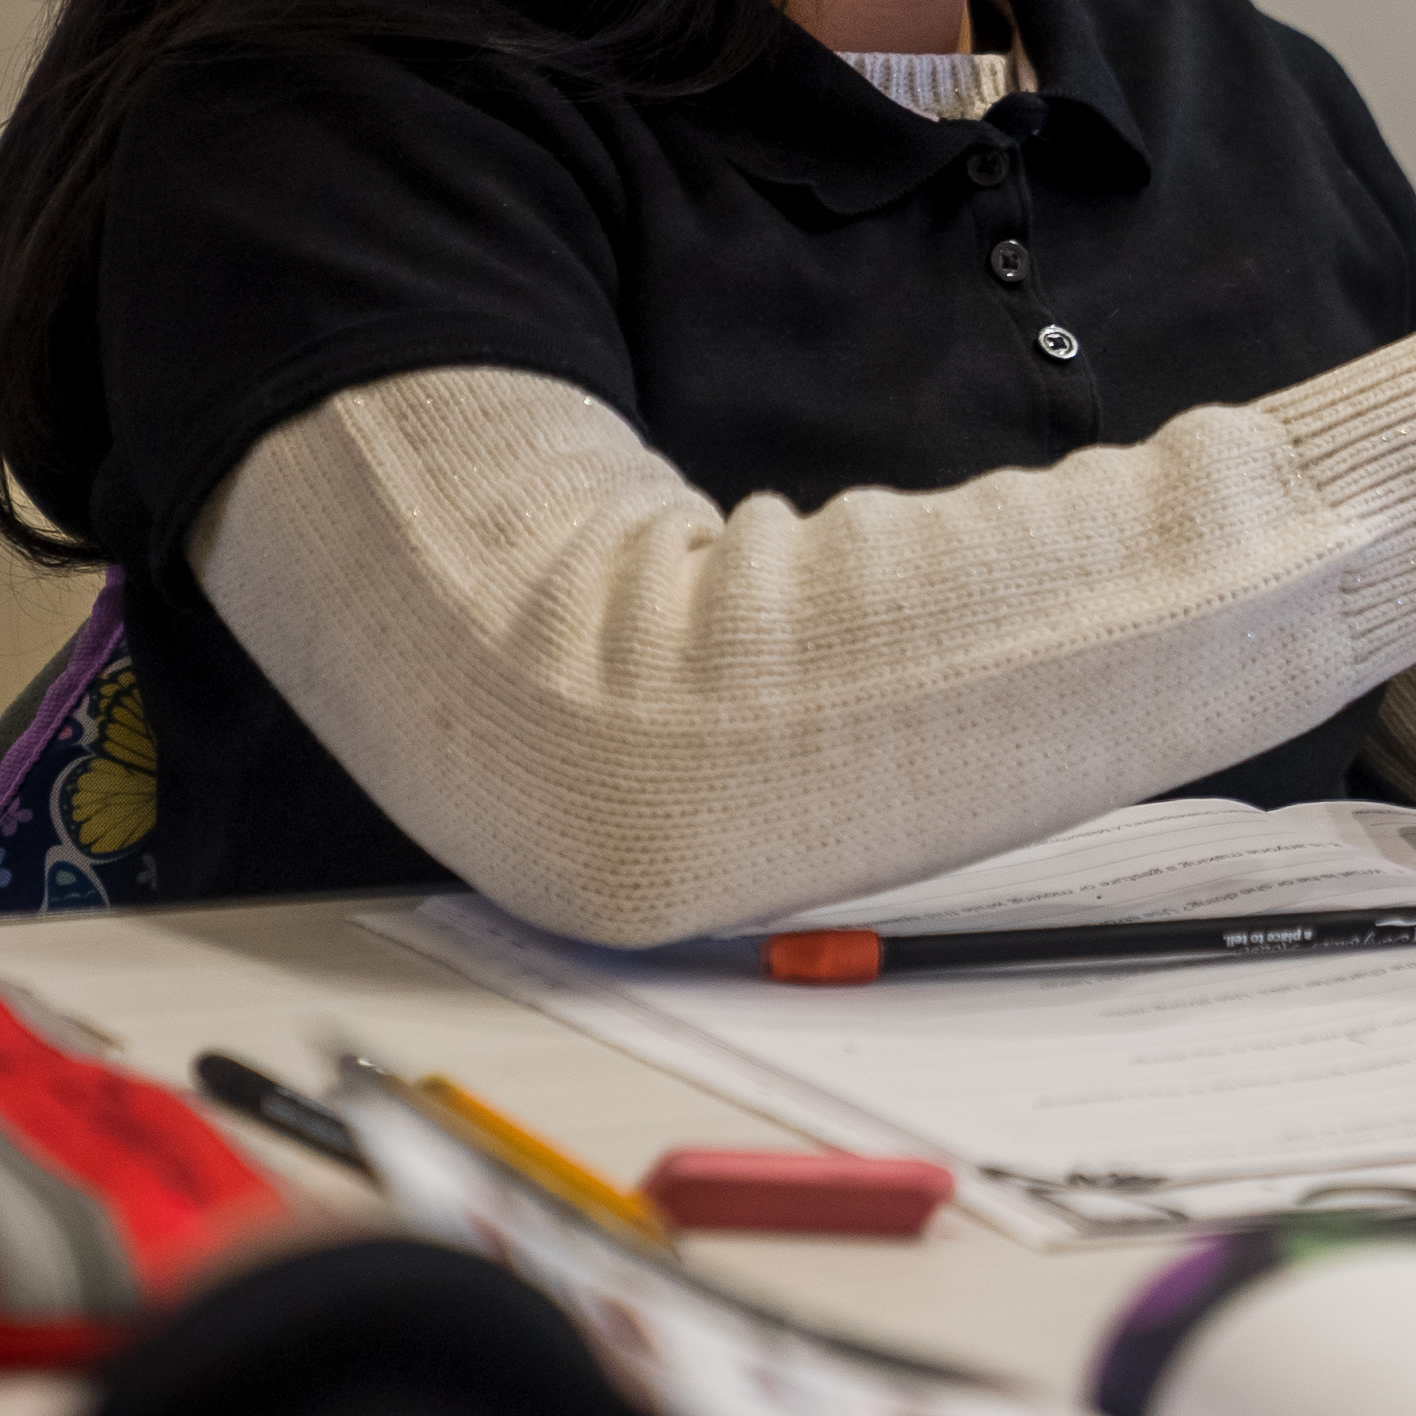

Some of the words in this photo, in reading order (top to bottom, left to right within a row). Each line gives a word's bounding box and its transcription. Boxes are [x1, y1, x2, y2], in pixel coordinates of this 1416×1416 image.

[1250, 932, 1264, 944] to
[1267, 927, 1301, 944] place
[1303, 929, 1313, 940] a
